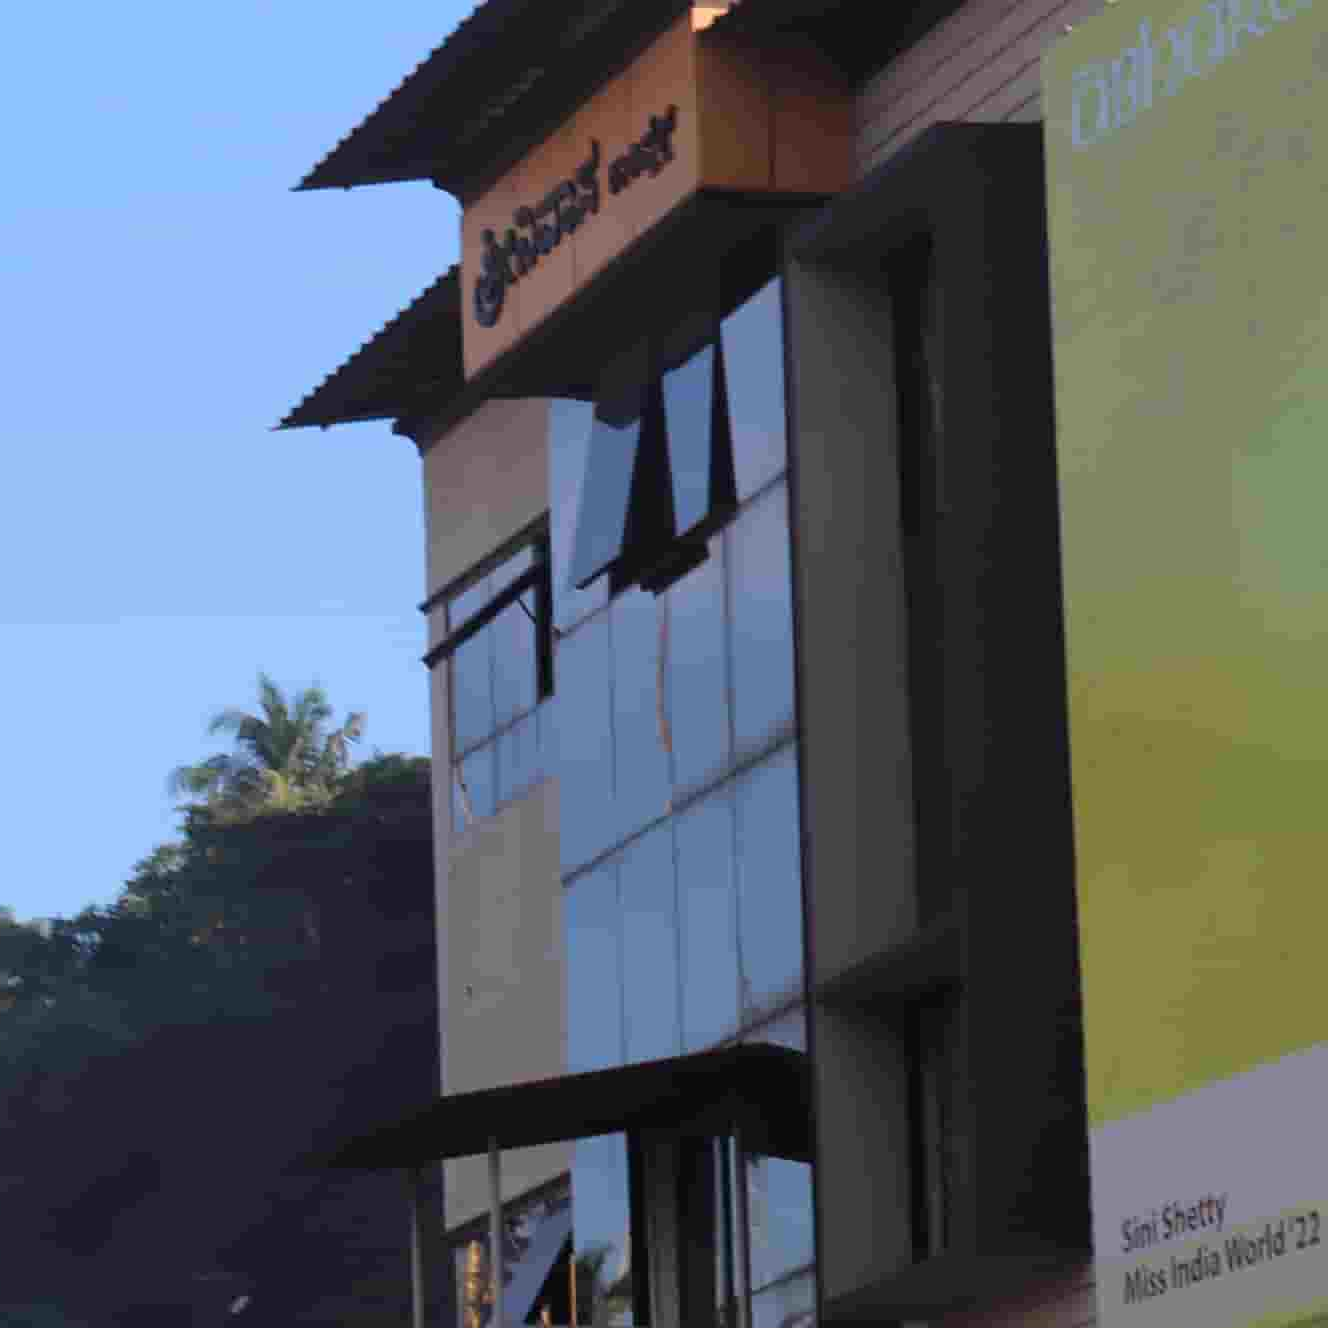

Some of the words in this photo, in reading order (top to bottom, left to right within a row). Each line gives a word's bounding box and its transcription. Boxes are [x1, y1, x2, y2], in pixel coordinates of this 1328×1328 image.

[1121, 1216, 1160, 1253] Sini
[1161, 1193, 1230, 1240] Shetty
[1122, 1264, 1169, 1304] Miss
[1170, 1246, 1223, 1290] India
[1224, 1217, 1287, 1273] World
